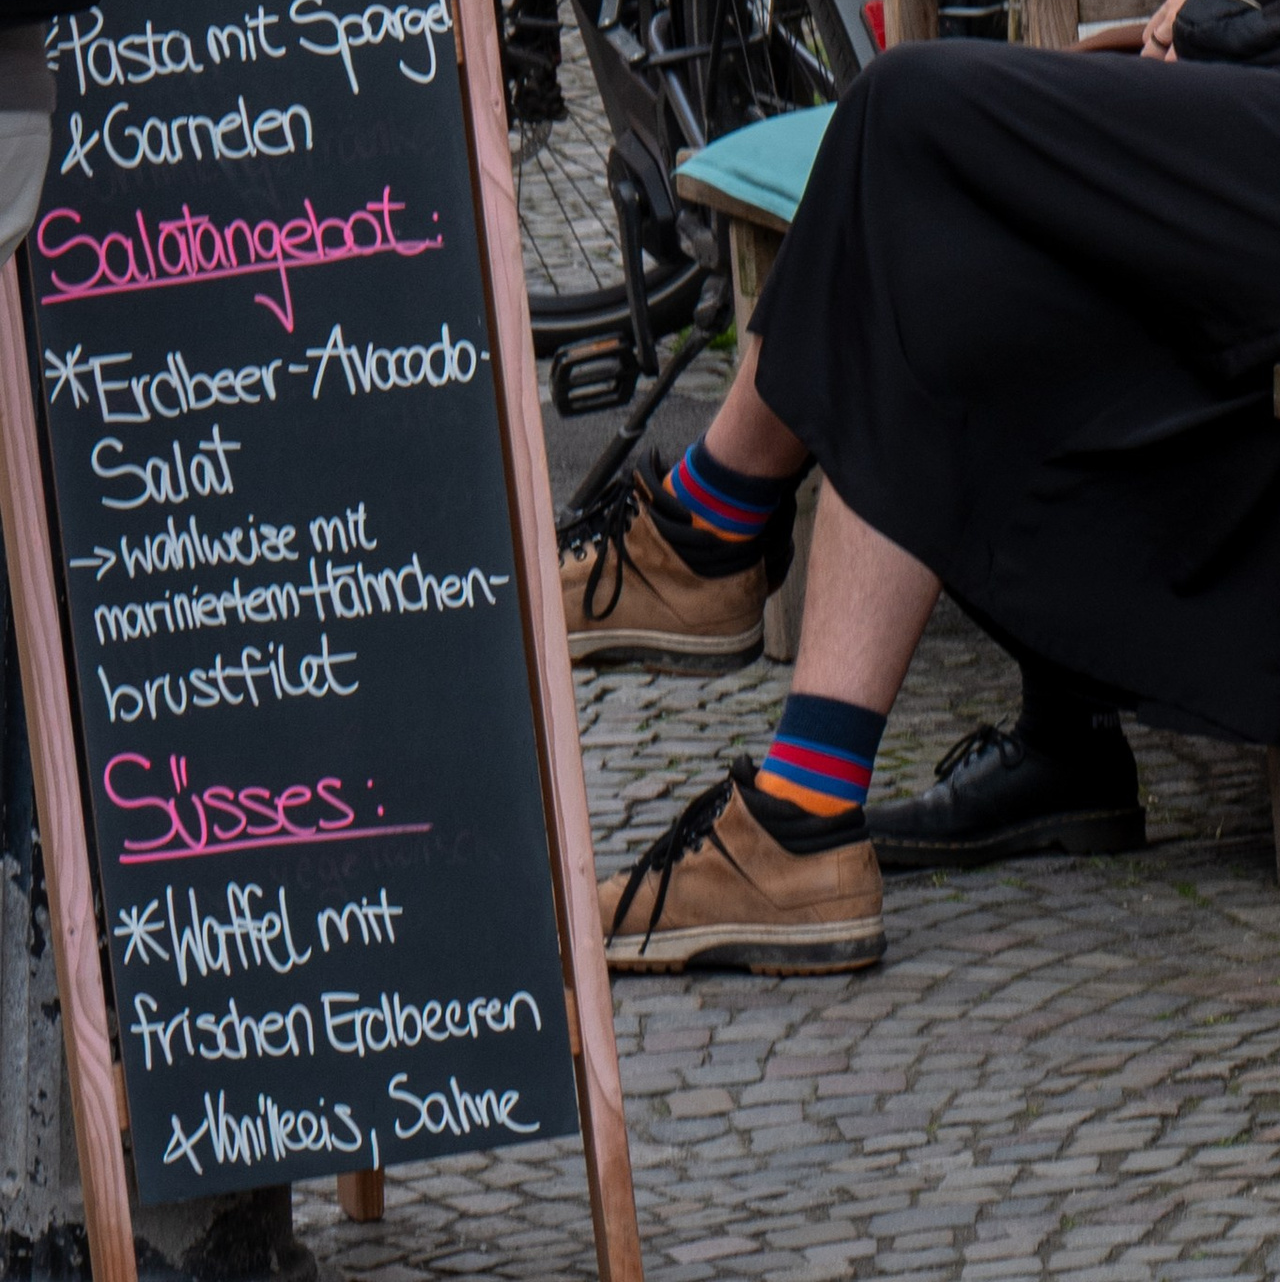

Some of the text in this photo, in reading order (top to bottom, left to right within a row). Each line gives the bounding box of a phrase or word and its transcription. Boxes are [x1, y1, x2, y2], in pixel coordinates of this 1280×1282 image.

[57, 6, 203, 95] Pasta
[207, 5, 286, 63] mit
[61, 112, 99, 177] &
[102, 95, 313, 169] Garnelen
[37, 186, 443, 332] Salatangebot:
[91, 423, 241, 509] Salat
[309, 503, 378, 554] mit
[94, 577, 300, 646] mariniertem
[98, 633, 360, 723] brustfilet
[104, 753, 386, 852] Süsses:
[166, 882, 404, 986] Waffel mit
[130, 988, 542, 1071] frischen Erdbeeren
[387, 1072, 541, 1140] Sahne
